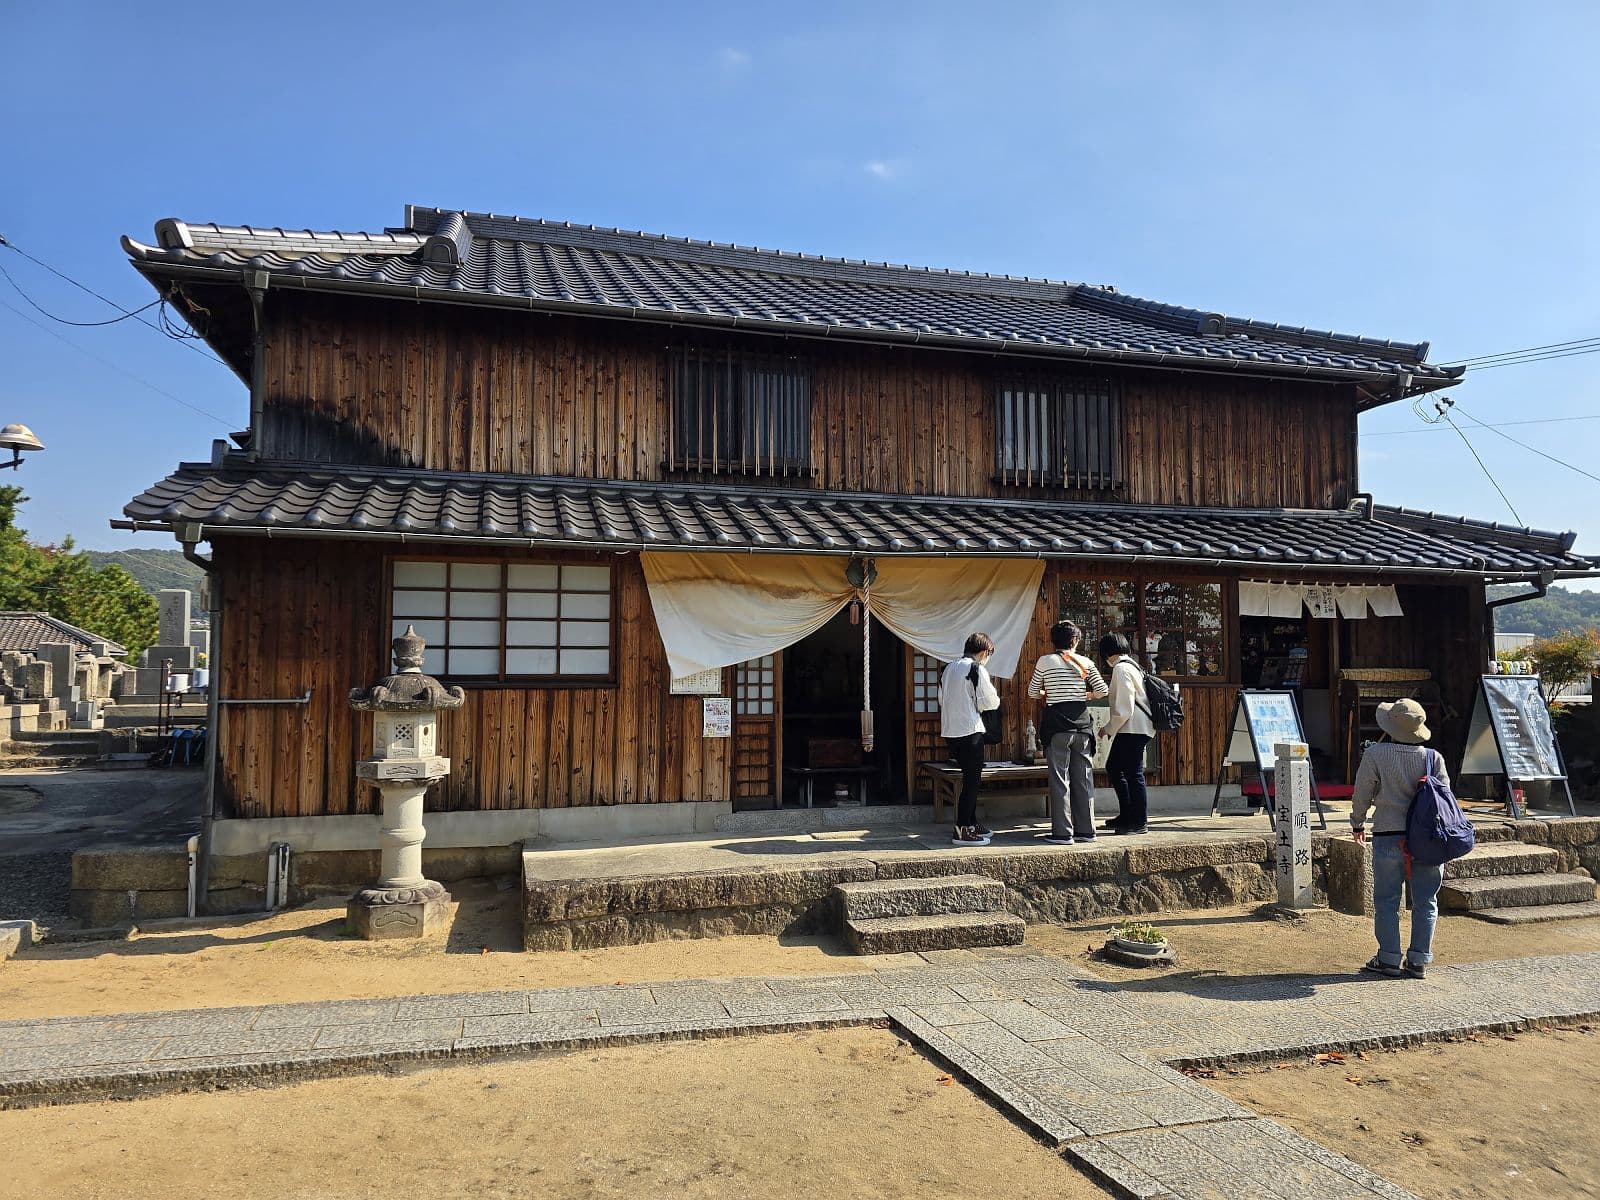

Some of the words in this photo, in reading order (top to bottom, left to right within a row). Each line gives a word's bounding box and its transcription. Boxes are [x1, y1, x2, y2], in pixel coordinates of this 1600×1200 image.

[1278, 805, 1292, 876] 宝土寺
[1294, 811, 1310, 867] 順路
